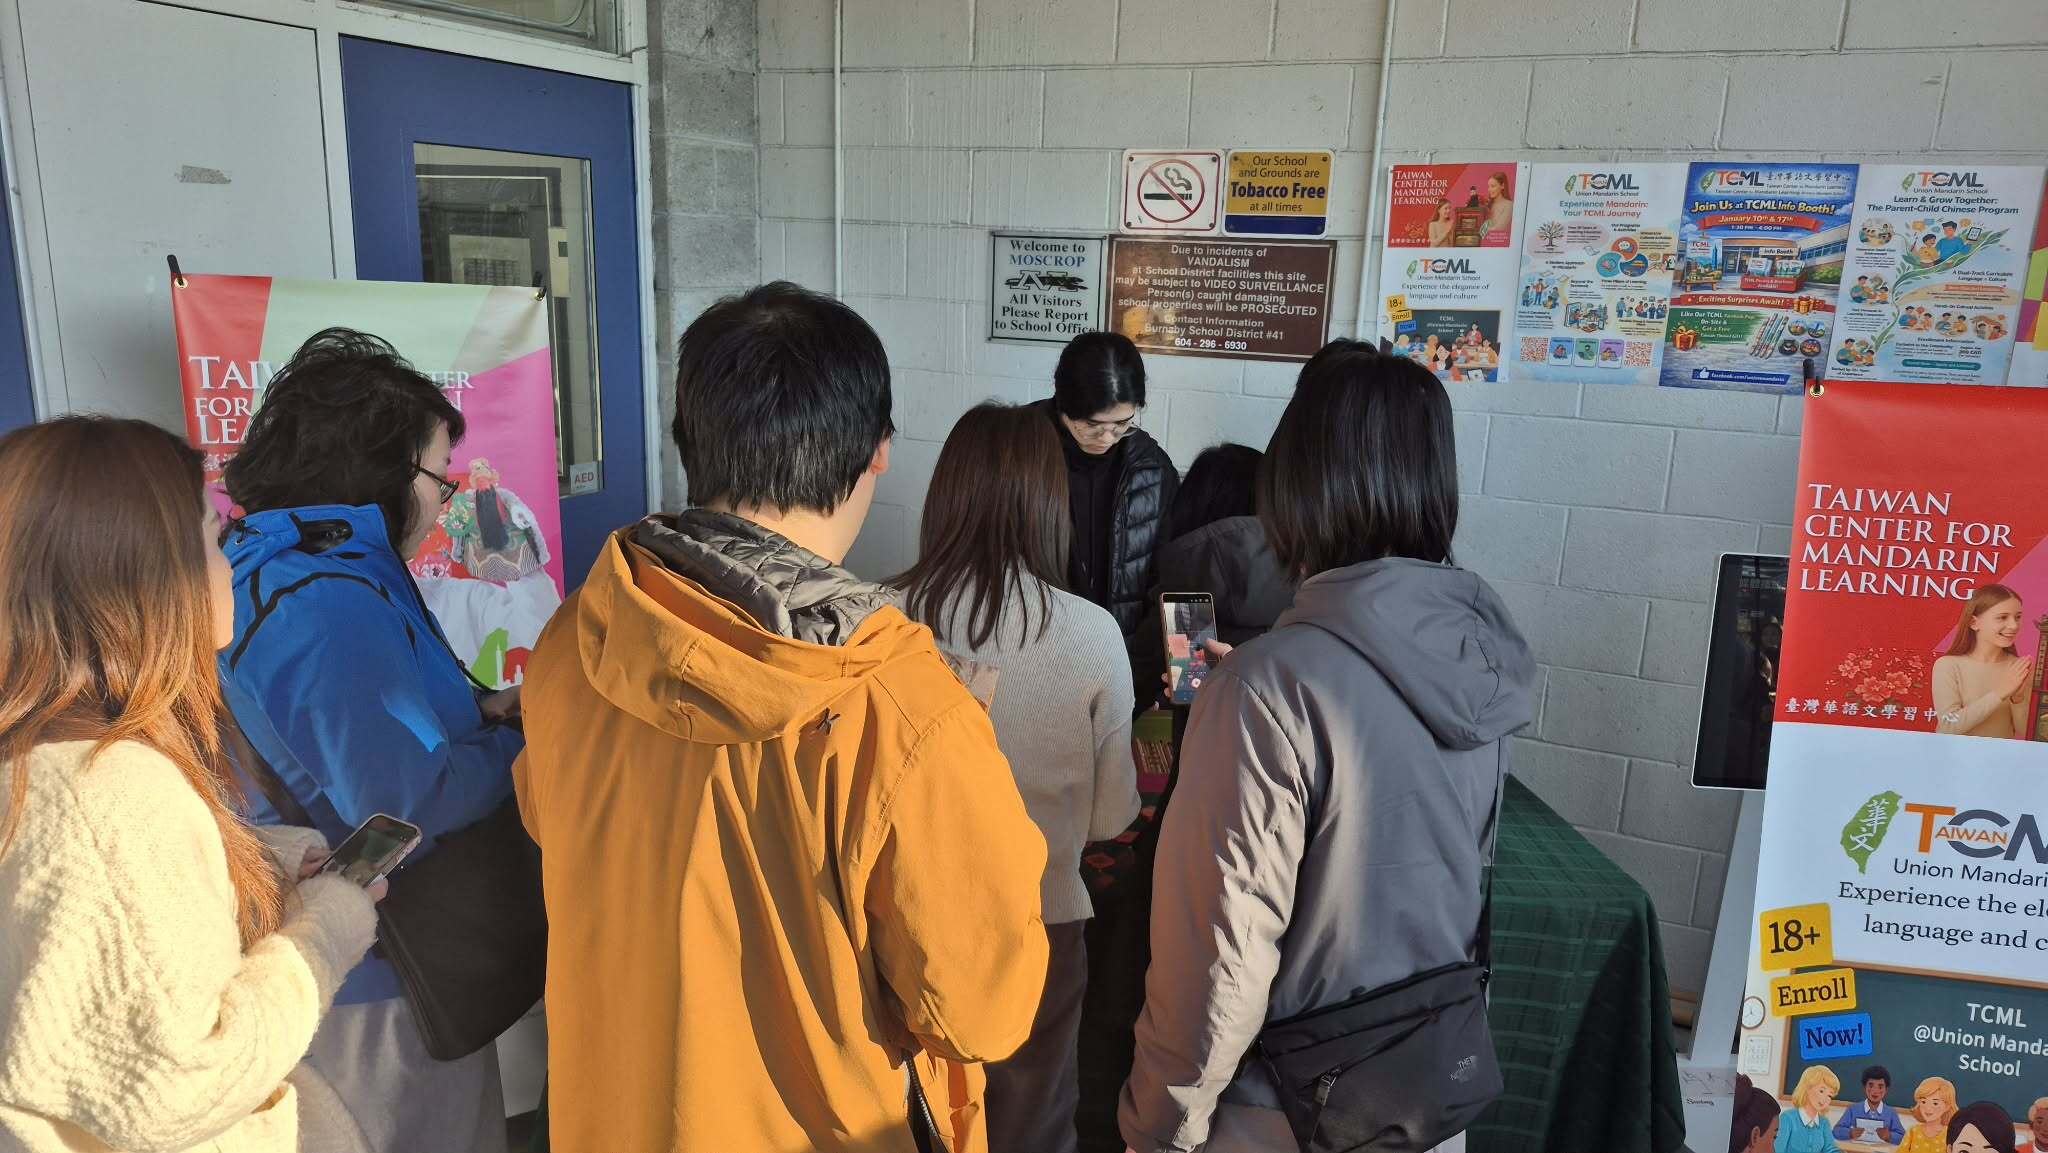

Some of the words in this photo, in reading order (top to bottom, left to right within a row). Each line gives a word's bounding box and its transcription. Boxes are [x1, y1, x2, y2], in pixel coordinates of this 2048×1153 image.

[1253, 156, 1271, 166] Our
[1274, 156, 1307, 166] School
[1238, 168, 1257, 177] and
[1260, 168, 1301, 178] Grounds
[1304, 170, 1320, 178] are
[1395, 170, 1432, 180] TAIWAN
[1717, 170, 1764, 186] TCML
[1918, 172, 1984, 188] TCML
[1395, 180, 1429, 188] CENTER
[1431, 180, 1448, 188] FOR
[1579, 173, 1640, 190] TCML
[1231, 182, 1288, 198] Tobacco
[1292, 182, 1326, 198] Free
[1394, 188, 1446, 196] MANDARIN
[1250, 203, 1258, 211] at
[1262, 202, 1272, 211] all
[1275, 202, 1303, 212] times
[1394, 196, 1440, 205] LEARNING
[1692, 202, 1716, 212] Join
[1720, 201, 1732, 210] Us
[1745, 200, 1776, 210] TCML
[1778, 201, 1796, 210] Info
[1798, 202, 1835, 215] Booth!
[1607, 210, 1641, 218] Journey
[1978, 206, 2019, 215] Program
[1720, 215, 1750, 223] January
[1010, 240, 1068, 252] Welcome
[1073, 243, 1085, 253] to
[1172, 245, 1190, 254] Due
[1194, 246, 1203, 254] to
[1206, 246, 1253, 256] incidents
[1256, 248, 1267, 256] of
[1010, 254, 1085, 267] MOSCROP
[1188, 257, 1249, 267] VANDALISM
[1420, 258, 1476, 274] TCML
[1133, 266, 1141, 274] at
[1146, 266, 1177, 275] School
[1181, 268, 1215, 277] District
[1218, 269, 1261, 279] facilities
[1264, 271, 1284, 280] this
[1287, 272, 1306, 281] site
[1116, 276, 1135, 286] may
[1138, 276, 1149, 285] be
[1152, 278, 1187, 288] subject
[1191, 279, 1200, 287] to
[1204, 280, 1236, 289] VIDEO
[1239, 280, 1325, 293] SURVEILLANCE
[1010, 294, 1028, 304] All
[1032, 294, 1082, 307] Visitors
[1148, 288, 1194, 300] Person(s)
[1198, 290, 1231, 303] caught
[1235, 292, 1286, 305] damaging
[1727, 296, 1759, 305] Surprises
[1002, 306, 1040, 318] Please
[1045, 308, 1088, 322] Report
[1118, 298, 1150, 307] school
[1153, 300, 1203, 310] properties
[1206, 302, 1222, 311] will
[1226, 303, 1238, 312] be
[1241, 304, 1317, 316] PROSECUTED
[1164, 314, 1202, 324] Contact
[1206, 317, 1264, 327] Information
[1392, 312, 1410, 320] Enroll
[995, 320, 1006, 329] to
[1010, 320, 1051, 332] School
[1145, 323, 1186, 336] Burnaby
[1189, 326, 1223, 336] School
[1226, 328, 1263, 338] District
[1266, 331, 1283, 340] #41
[1175, 338, 1191, 346] 604
[1200, 339, 1216, 348] 296
[1224, 341, 1247, 350] 6930
[193, 397, 256, 417] FOR
[575, 472, 594, 484] AED
[1808, 482, 1952, 516] TAIWAN
[1804, 514, 1936, 543] CENTER
[1944, 522, 2016, 548] FOR
[1800, 541, 2000, 574] MANDARIN
[1799, 569, 1977, 601] LEARNING
[1784, 697, 1961, 724] 臺灣華語文學習中心
[1893, 857, 1953, 879] Union
[1838, 881, 1970, 910] Experience
[1978, 893, 2017, 915] the
[1768, 919, 1821, 954] 18+
[1864, 914, 1974, 946] language
[1980, 930, 2027, 949] and
[1777, 977, 1848, 1007] Enroll
[1966, 1002, 2027, 1028] TCML
[1805, 1022, 1864, 1049] Now!
[1913, 1025, 1985, 1048] @Union
[1958, 1054, 2021, 1077] School
